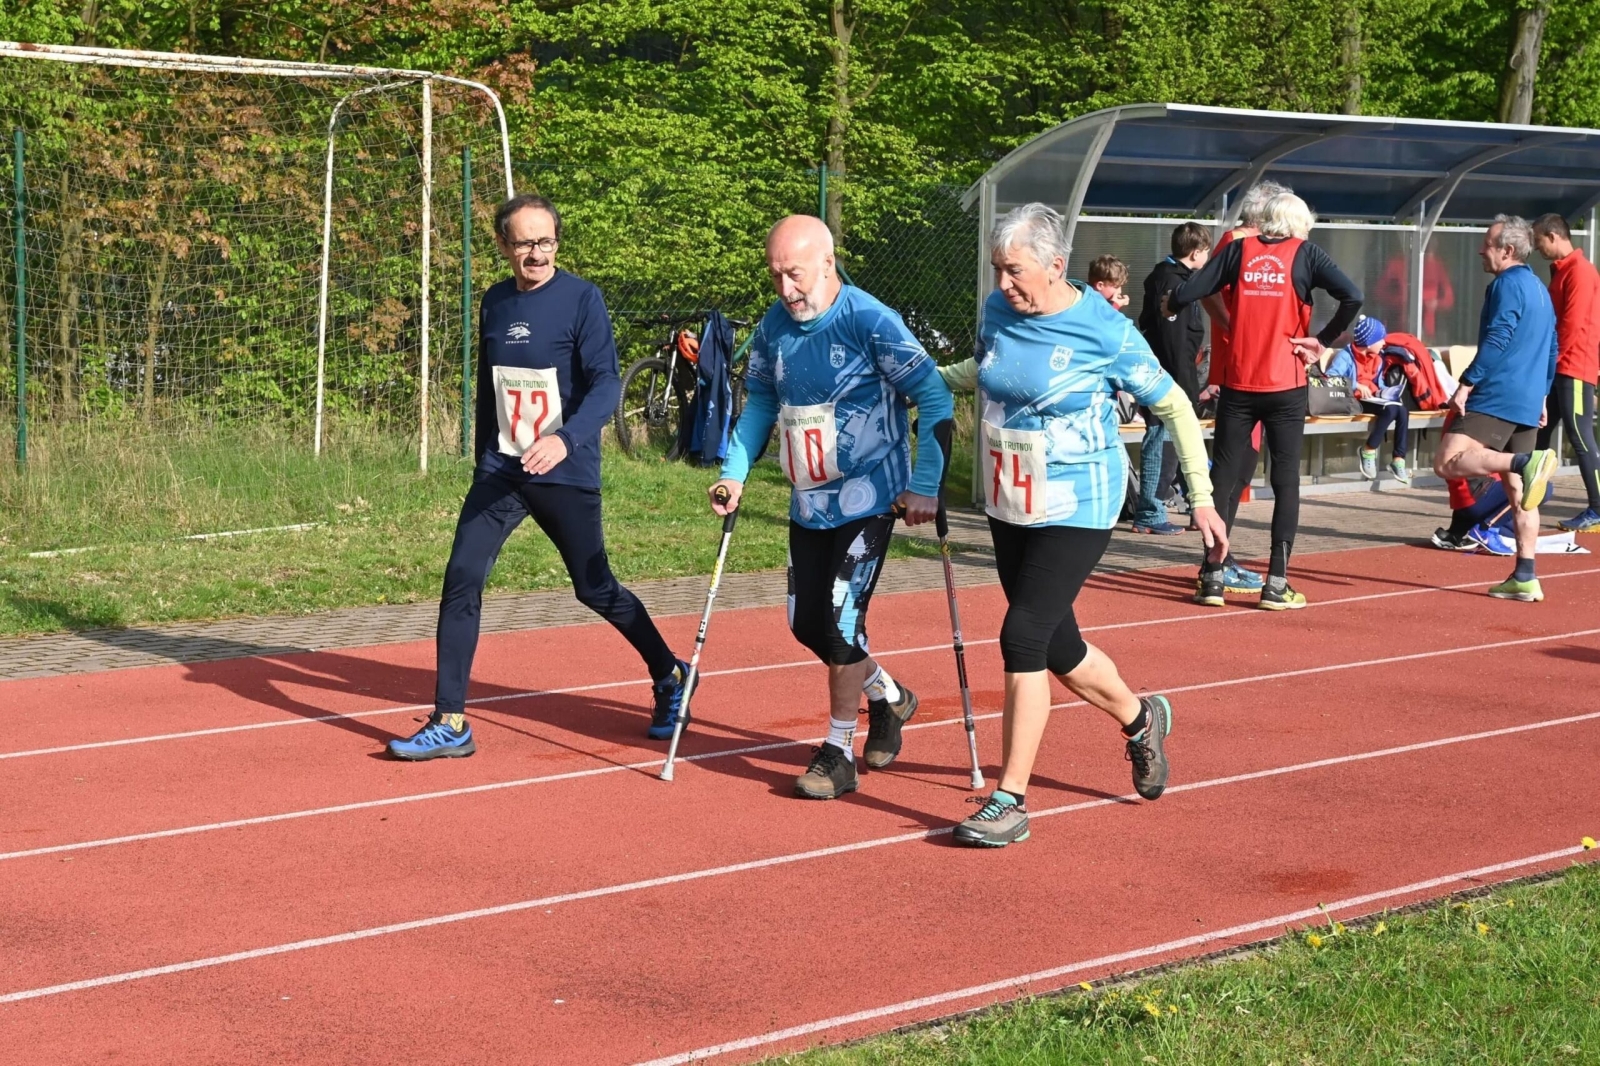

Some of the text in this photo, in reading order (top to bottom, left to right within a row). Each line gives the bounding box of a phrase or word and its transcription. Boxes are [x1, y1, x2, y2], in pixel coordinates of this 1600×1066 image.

[522, 380, 548, 389] TRUTNOV
[798, 415, 825, 426] TRUTNOV
[1003, 440, 1033, 452] TRUTNOV
[785, 428, 827, 484] 10
[990, 449, 1032, 514] 74
